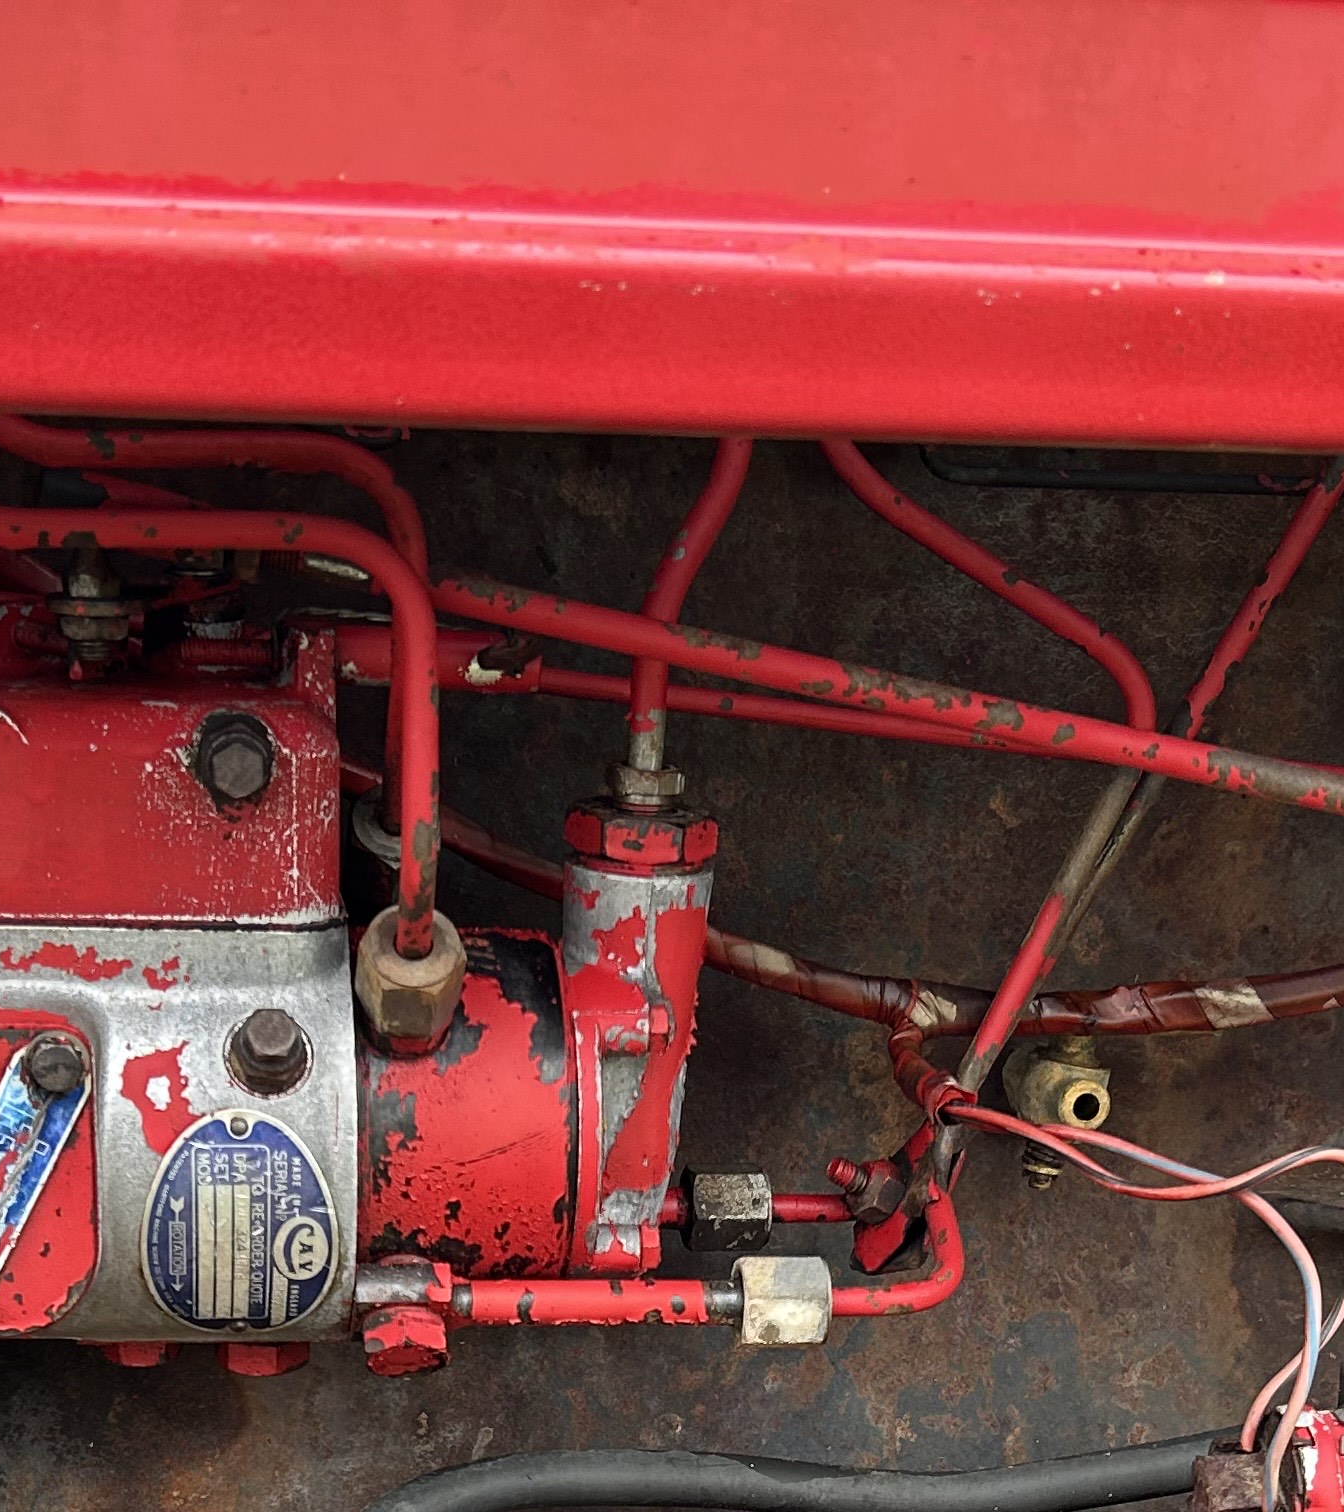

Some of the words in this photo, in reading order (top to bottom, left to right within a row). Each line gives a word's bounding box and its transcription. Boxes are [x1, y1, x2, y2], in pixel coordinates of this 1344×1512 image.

[197, 1153, 211, 1186] MOD
[215, 1153, 228, 1182] SET
[232, 1153, 248, 1183] DPA
[271, 1150, 288, 1199] SERIAL
[292, 1156, 301, 1187] MADE
[251, 1176, 264, 1196] TO
[171, 1223, 185, 1273] ROTATION
[251, 1272, 264, 1304] QUOTE
[288, 1284, 300, 1317] ENGLAND
